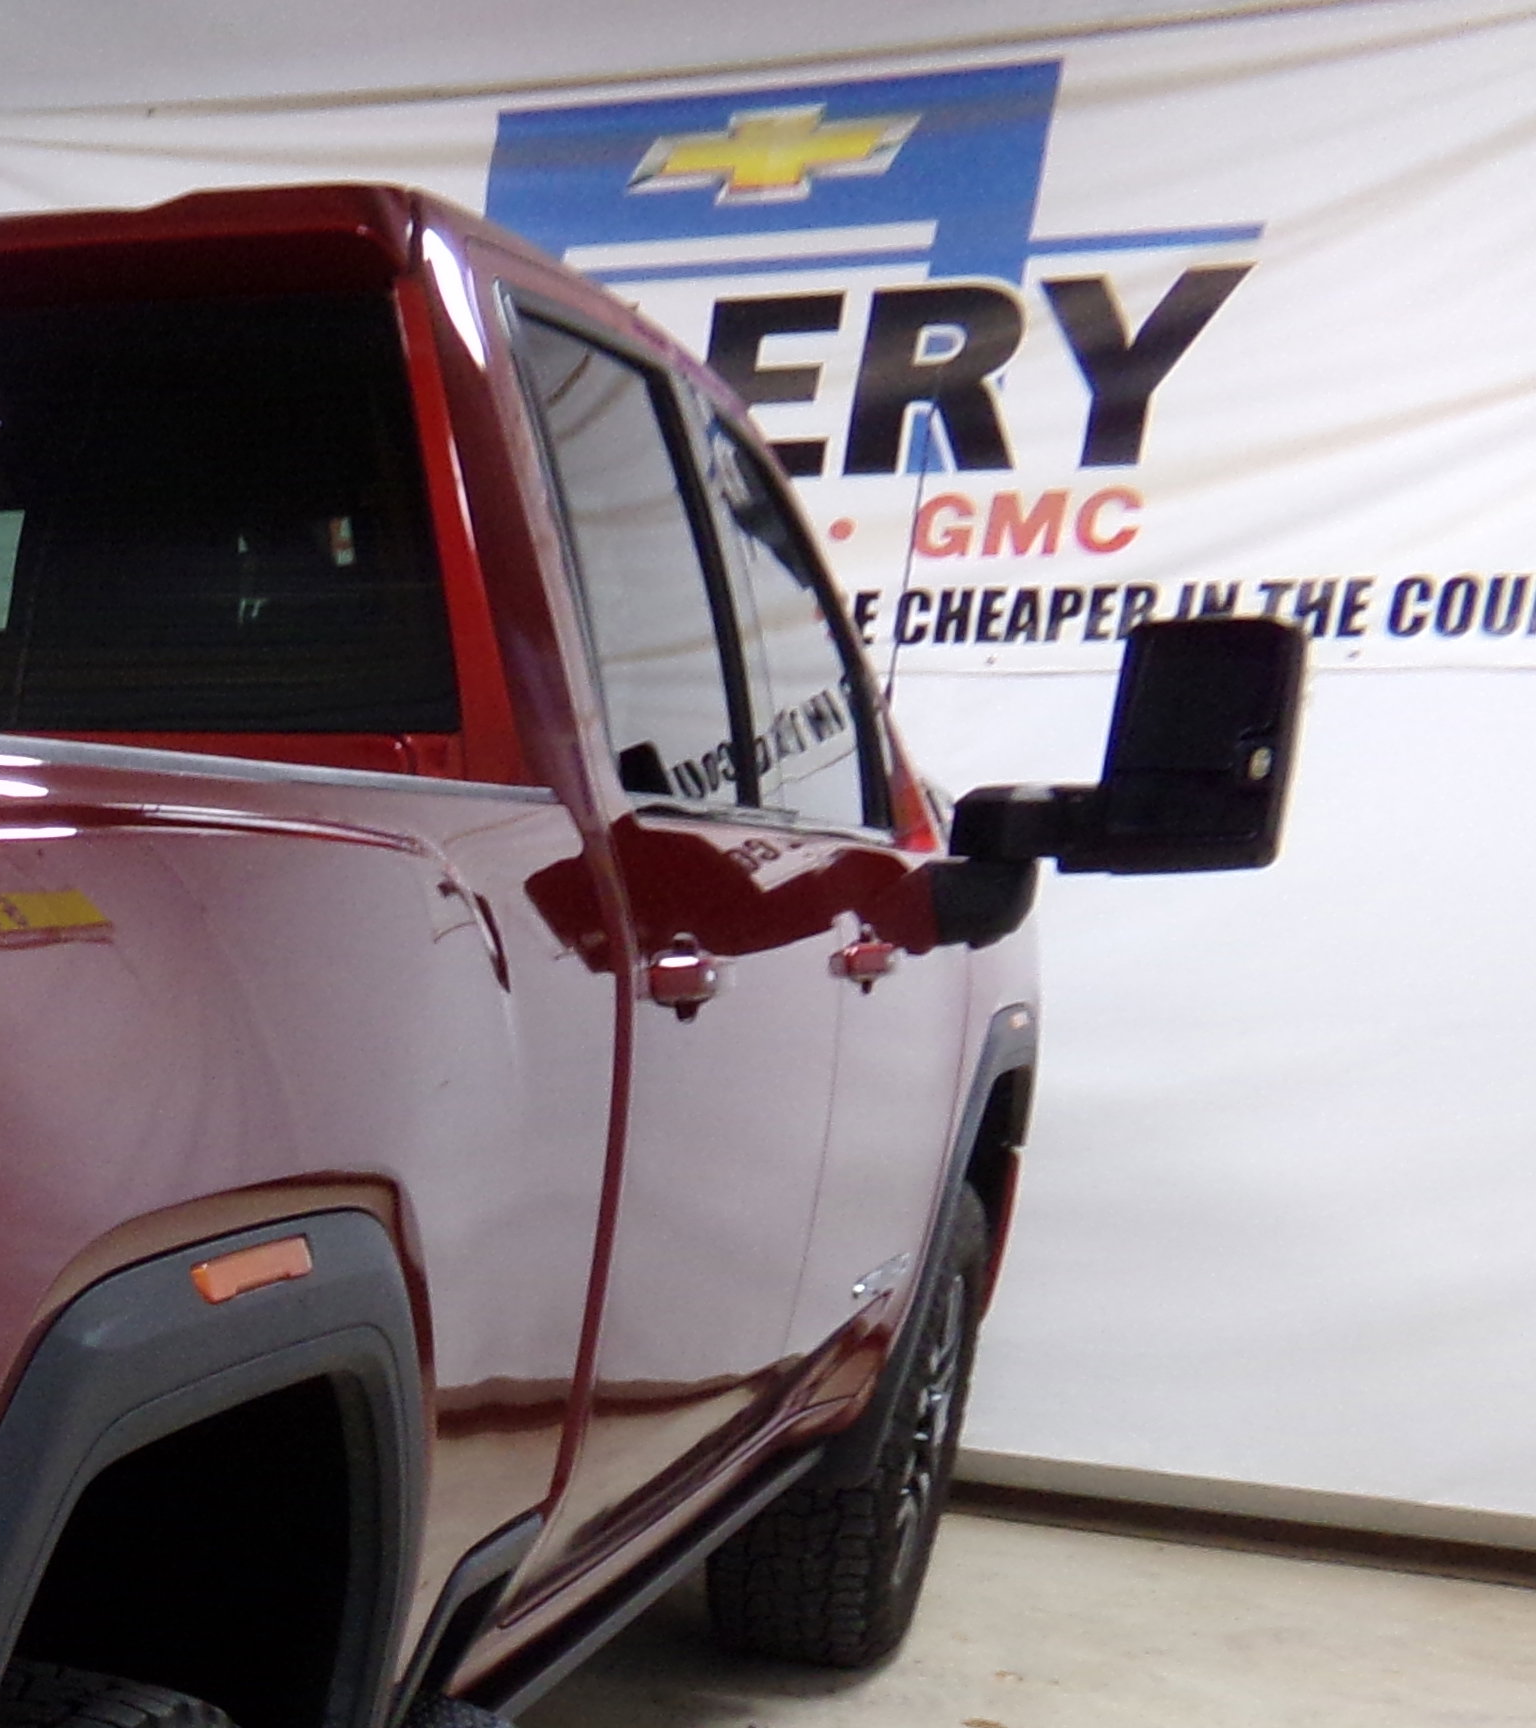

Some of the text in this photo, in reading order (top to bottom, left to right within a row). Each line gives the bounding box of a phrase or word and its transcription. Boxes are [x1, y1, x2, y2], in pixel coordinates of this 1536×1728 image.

[913, 487, 1143, 559] GMC
[894, 583, 1160, 644] CHEAPER
[1258, 577, 1375, 640] THE
[1387, 572, 1536, 639] COU
